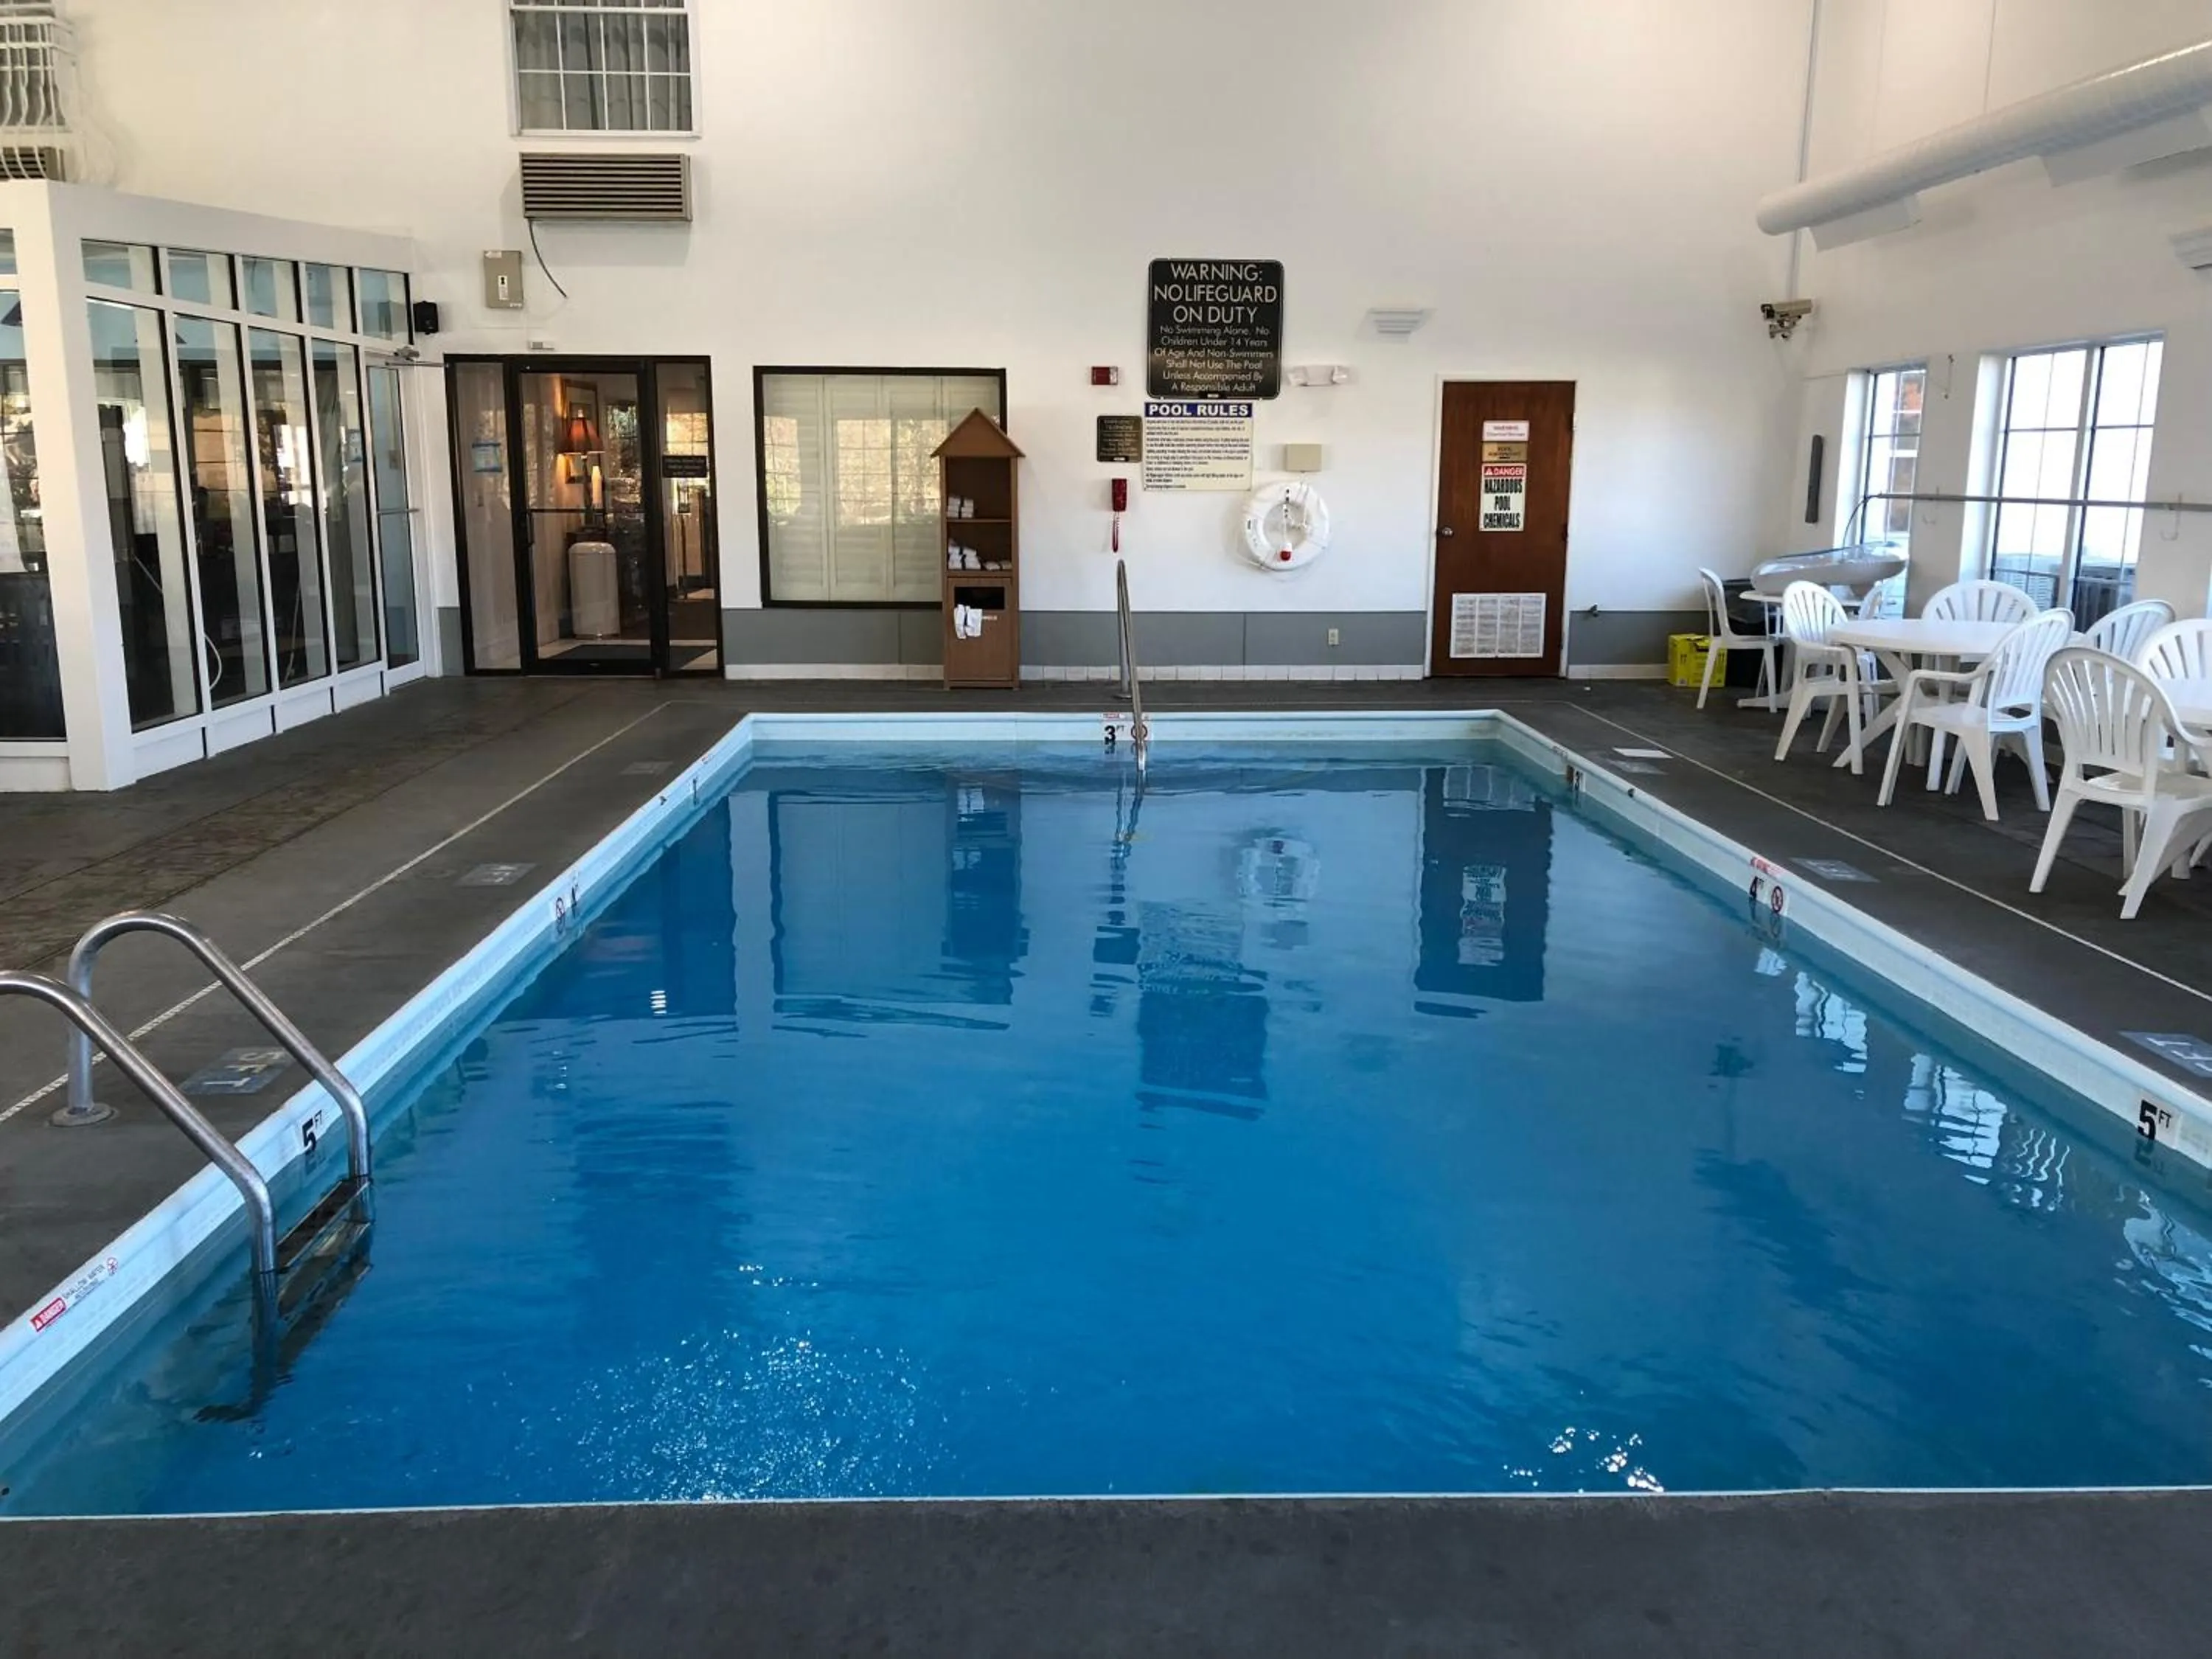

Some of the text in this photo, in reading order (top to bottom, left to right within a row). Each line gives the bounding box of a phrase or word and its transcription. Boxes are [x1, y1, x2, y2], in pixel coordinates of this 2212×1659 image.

[1170, 262, 1263, 282] WARNING:
[1154, 284, 1277, 303] NO LIFEGUARD
[1173, 305, 1259, 324] ON DUTY
[1160, 325, 1173, 334] No
[1256, 326, 1270, 335] No
[1161, 335, 1267, 347] Children Under 14 Years
[1187, 348, 1206, 358] And
[1166, 359, 1262, 369] Shall Not Use The Pool
[1172, 381, 1178, 390] A
[1149, 404, 1248, 416] POOL RULES
[1493, 467, 1523, 476] DANGER
[1484, 479, 1523, 493] HAZARDOUS
[1494, 495, 1511, 511] POOL
[1484, 512, 1520, 528] CHEMICALS
[1105, 726, 1115, 741] 3
[1750, 876, 1757, 899] 4
[2138, 1099, 2171, 1140] 5 FT
[302, 1117, 316, 1151] 5
